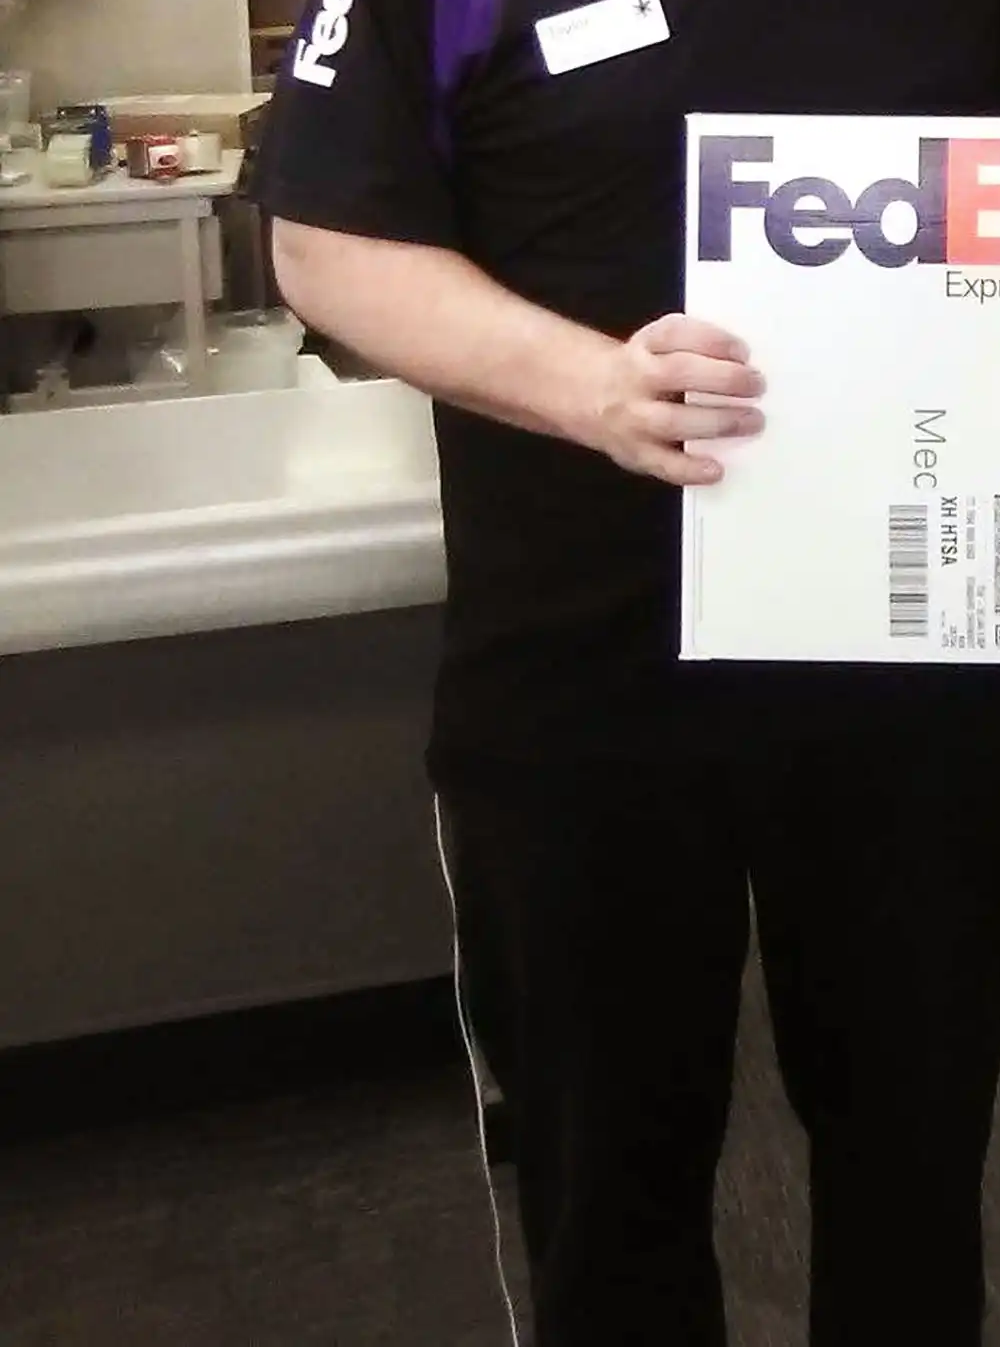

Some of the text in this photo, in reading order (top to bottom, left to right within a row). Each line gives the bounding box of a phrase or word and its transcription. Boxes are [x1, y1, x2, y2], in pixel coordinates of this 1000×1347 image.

[912, 409, 947, 490] Mec
[940, 496, 958, 568] XH HTSA
